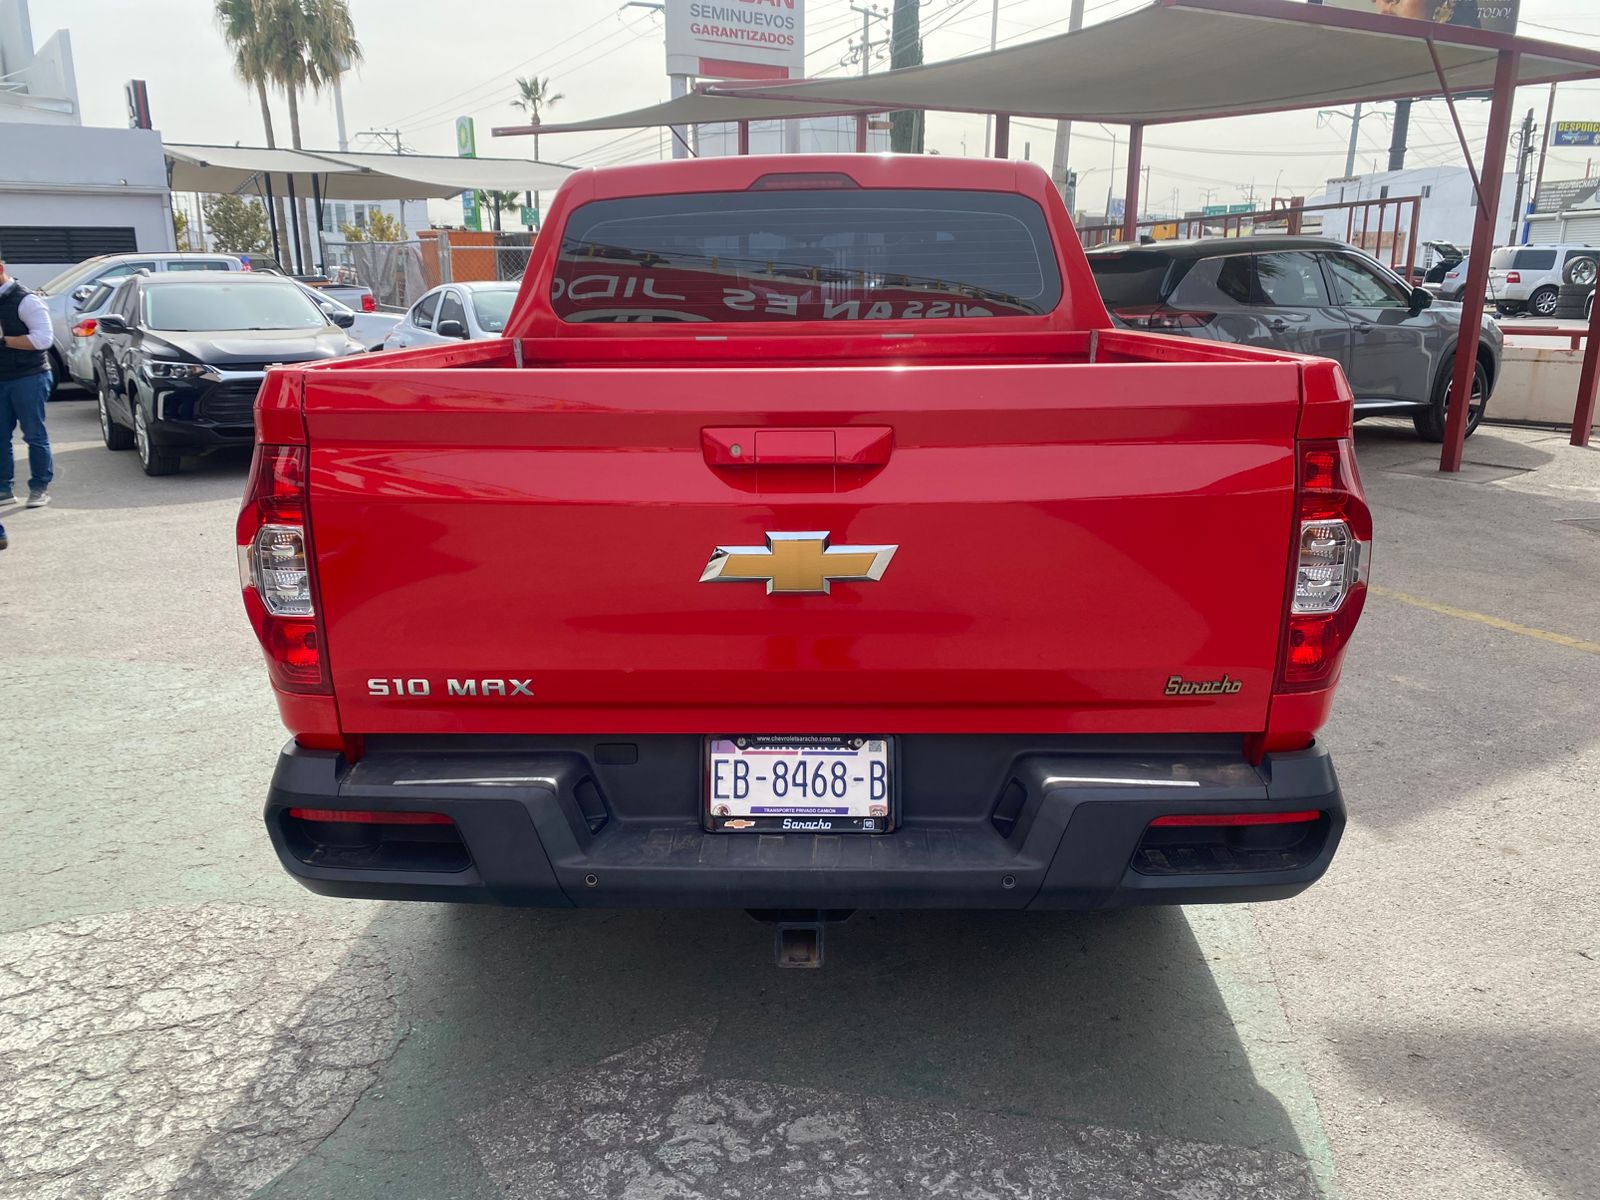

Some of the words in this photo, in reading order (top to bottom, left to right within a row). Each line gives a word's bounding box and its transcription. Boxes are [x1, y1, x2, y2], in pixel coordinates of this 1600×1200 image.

[689, 3, 795, 30] SEMINUEVOS
[690, 22, 795, 46] GARANTIZADOS
[1558, 122, 1600, 133] DESPONC
[367, 678, 431, 696] S10
[446, 678, 535, 696] MAX
[1164, 674, 1243, 695] Saracho
[756, 735, 841, 743] www.chevroletsaracho.com.mx
[713, 759, 887, 801] EB-8468-B
[782, 818, 832, 830] Saracho
